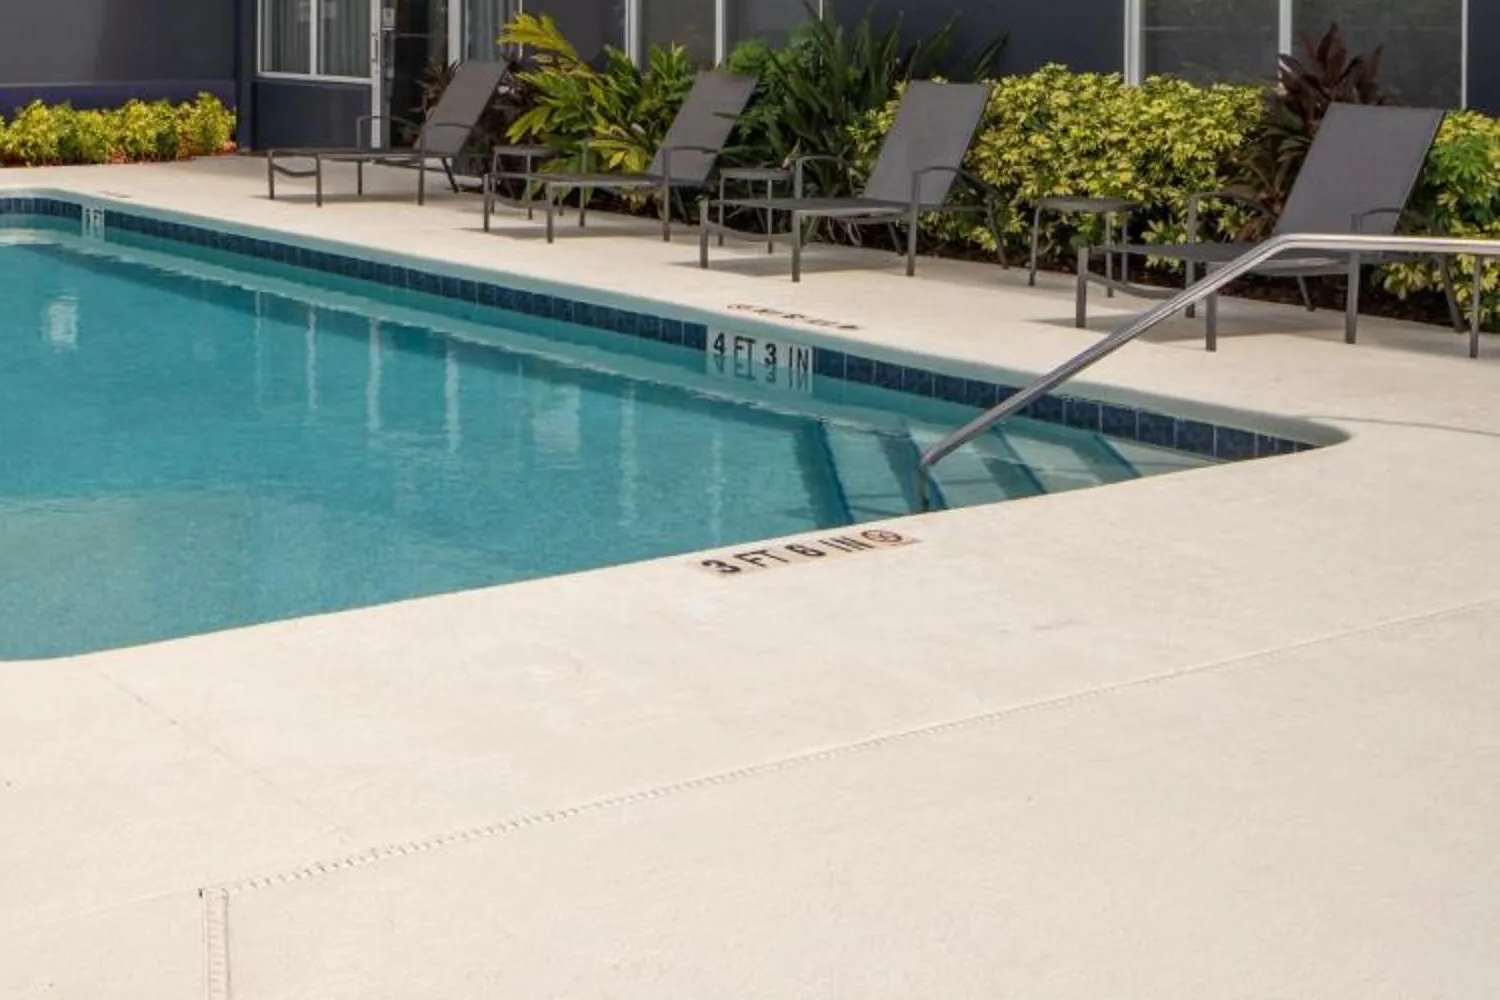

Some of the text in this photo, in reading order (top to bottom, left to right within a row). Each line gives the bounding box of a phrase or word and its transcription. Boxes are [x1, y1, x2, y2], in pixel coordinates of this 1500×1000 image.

[713, 331, 810, 374] 4 FT 3 IN
[701, 558, 742, 574] 3
[734, 548, 789, 569] FT
[819, 535, 876, 553] IN
